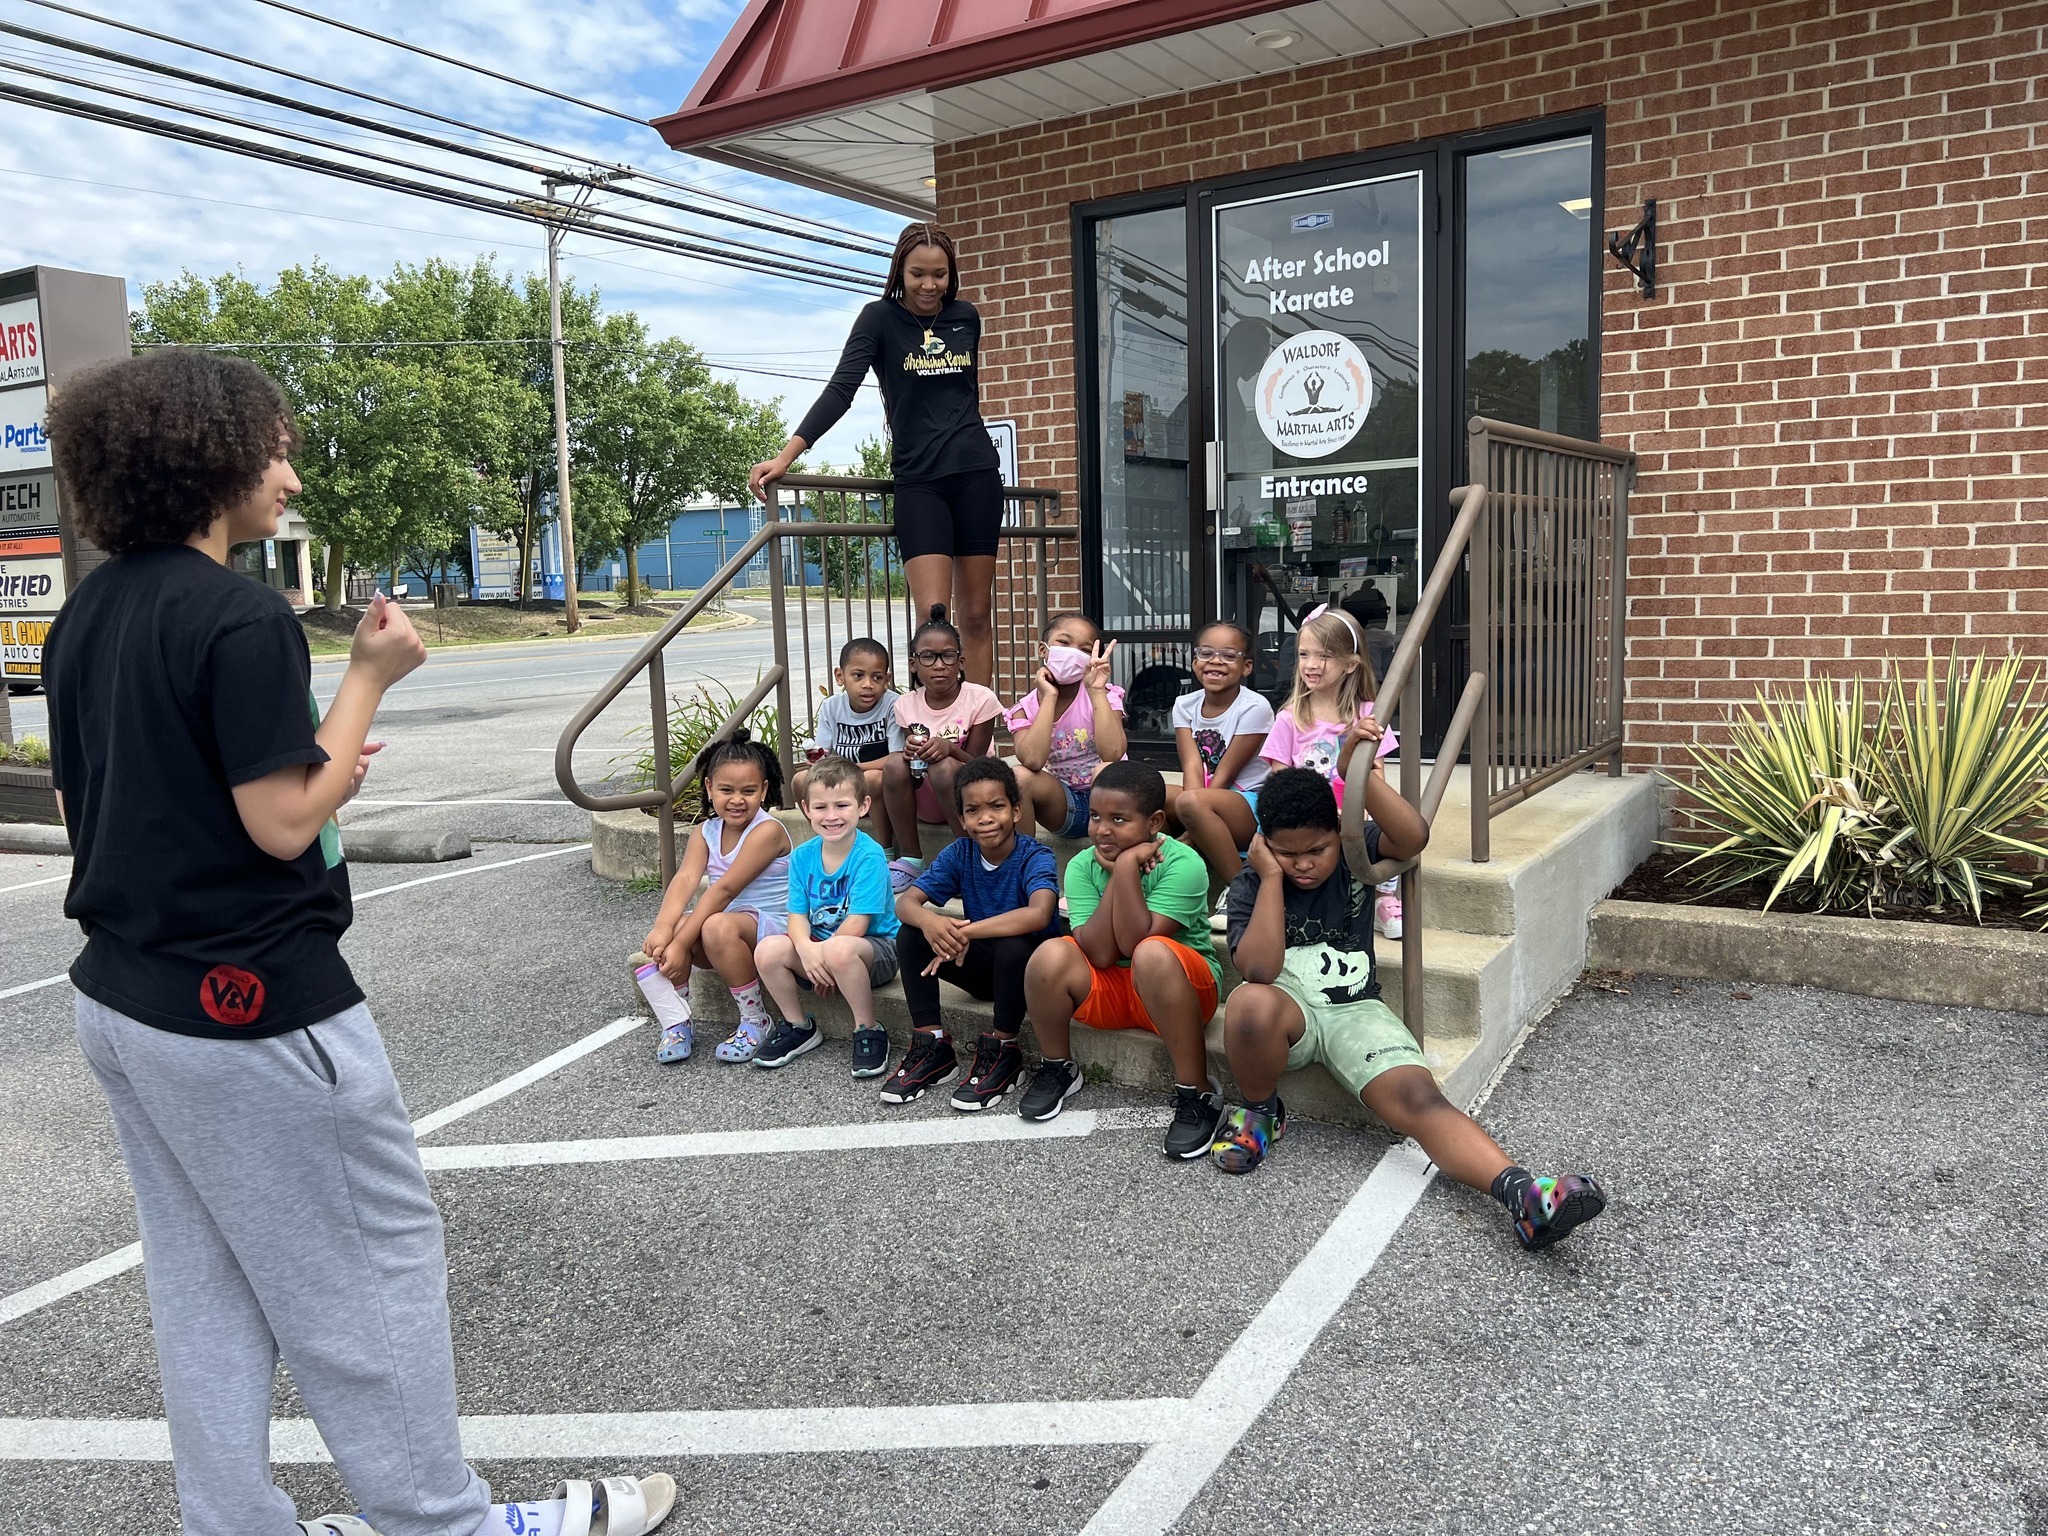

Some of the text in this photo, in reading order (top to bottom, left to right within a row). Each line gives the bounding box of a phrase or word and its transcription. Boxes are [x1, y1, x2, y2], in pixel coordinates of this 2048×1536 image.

[1244, 240, 1389, 284] After School
[1269, 285, 1354, 315] Karate
[0, 322, 37, 361] ARTS
[1282, 341, 1341, 364] WALDORF
[916, 367, 963, 376] VOLLEYBALL
[5, 422, 47, 448] Parts
[1276, 411, 1355, 437] MARTIAL ARTS
[1261, 475, 1368, 499] Entrance
[2, 511, 40, 523] AUTOMOTIVE
[1, 621, 16, 646] EL
[4, 647, 28, 659] AUTO
